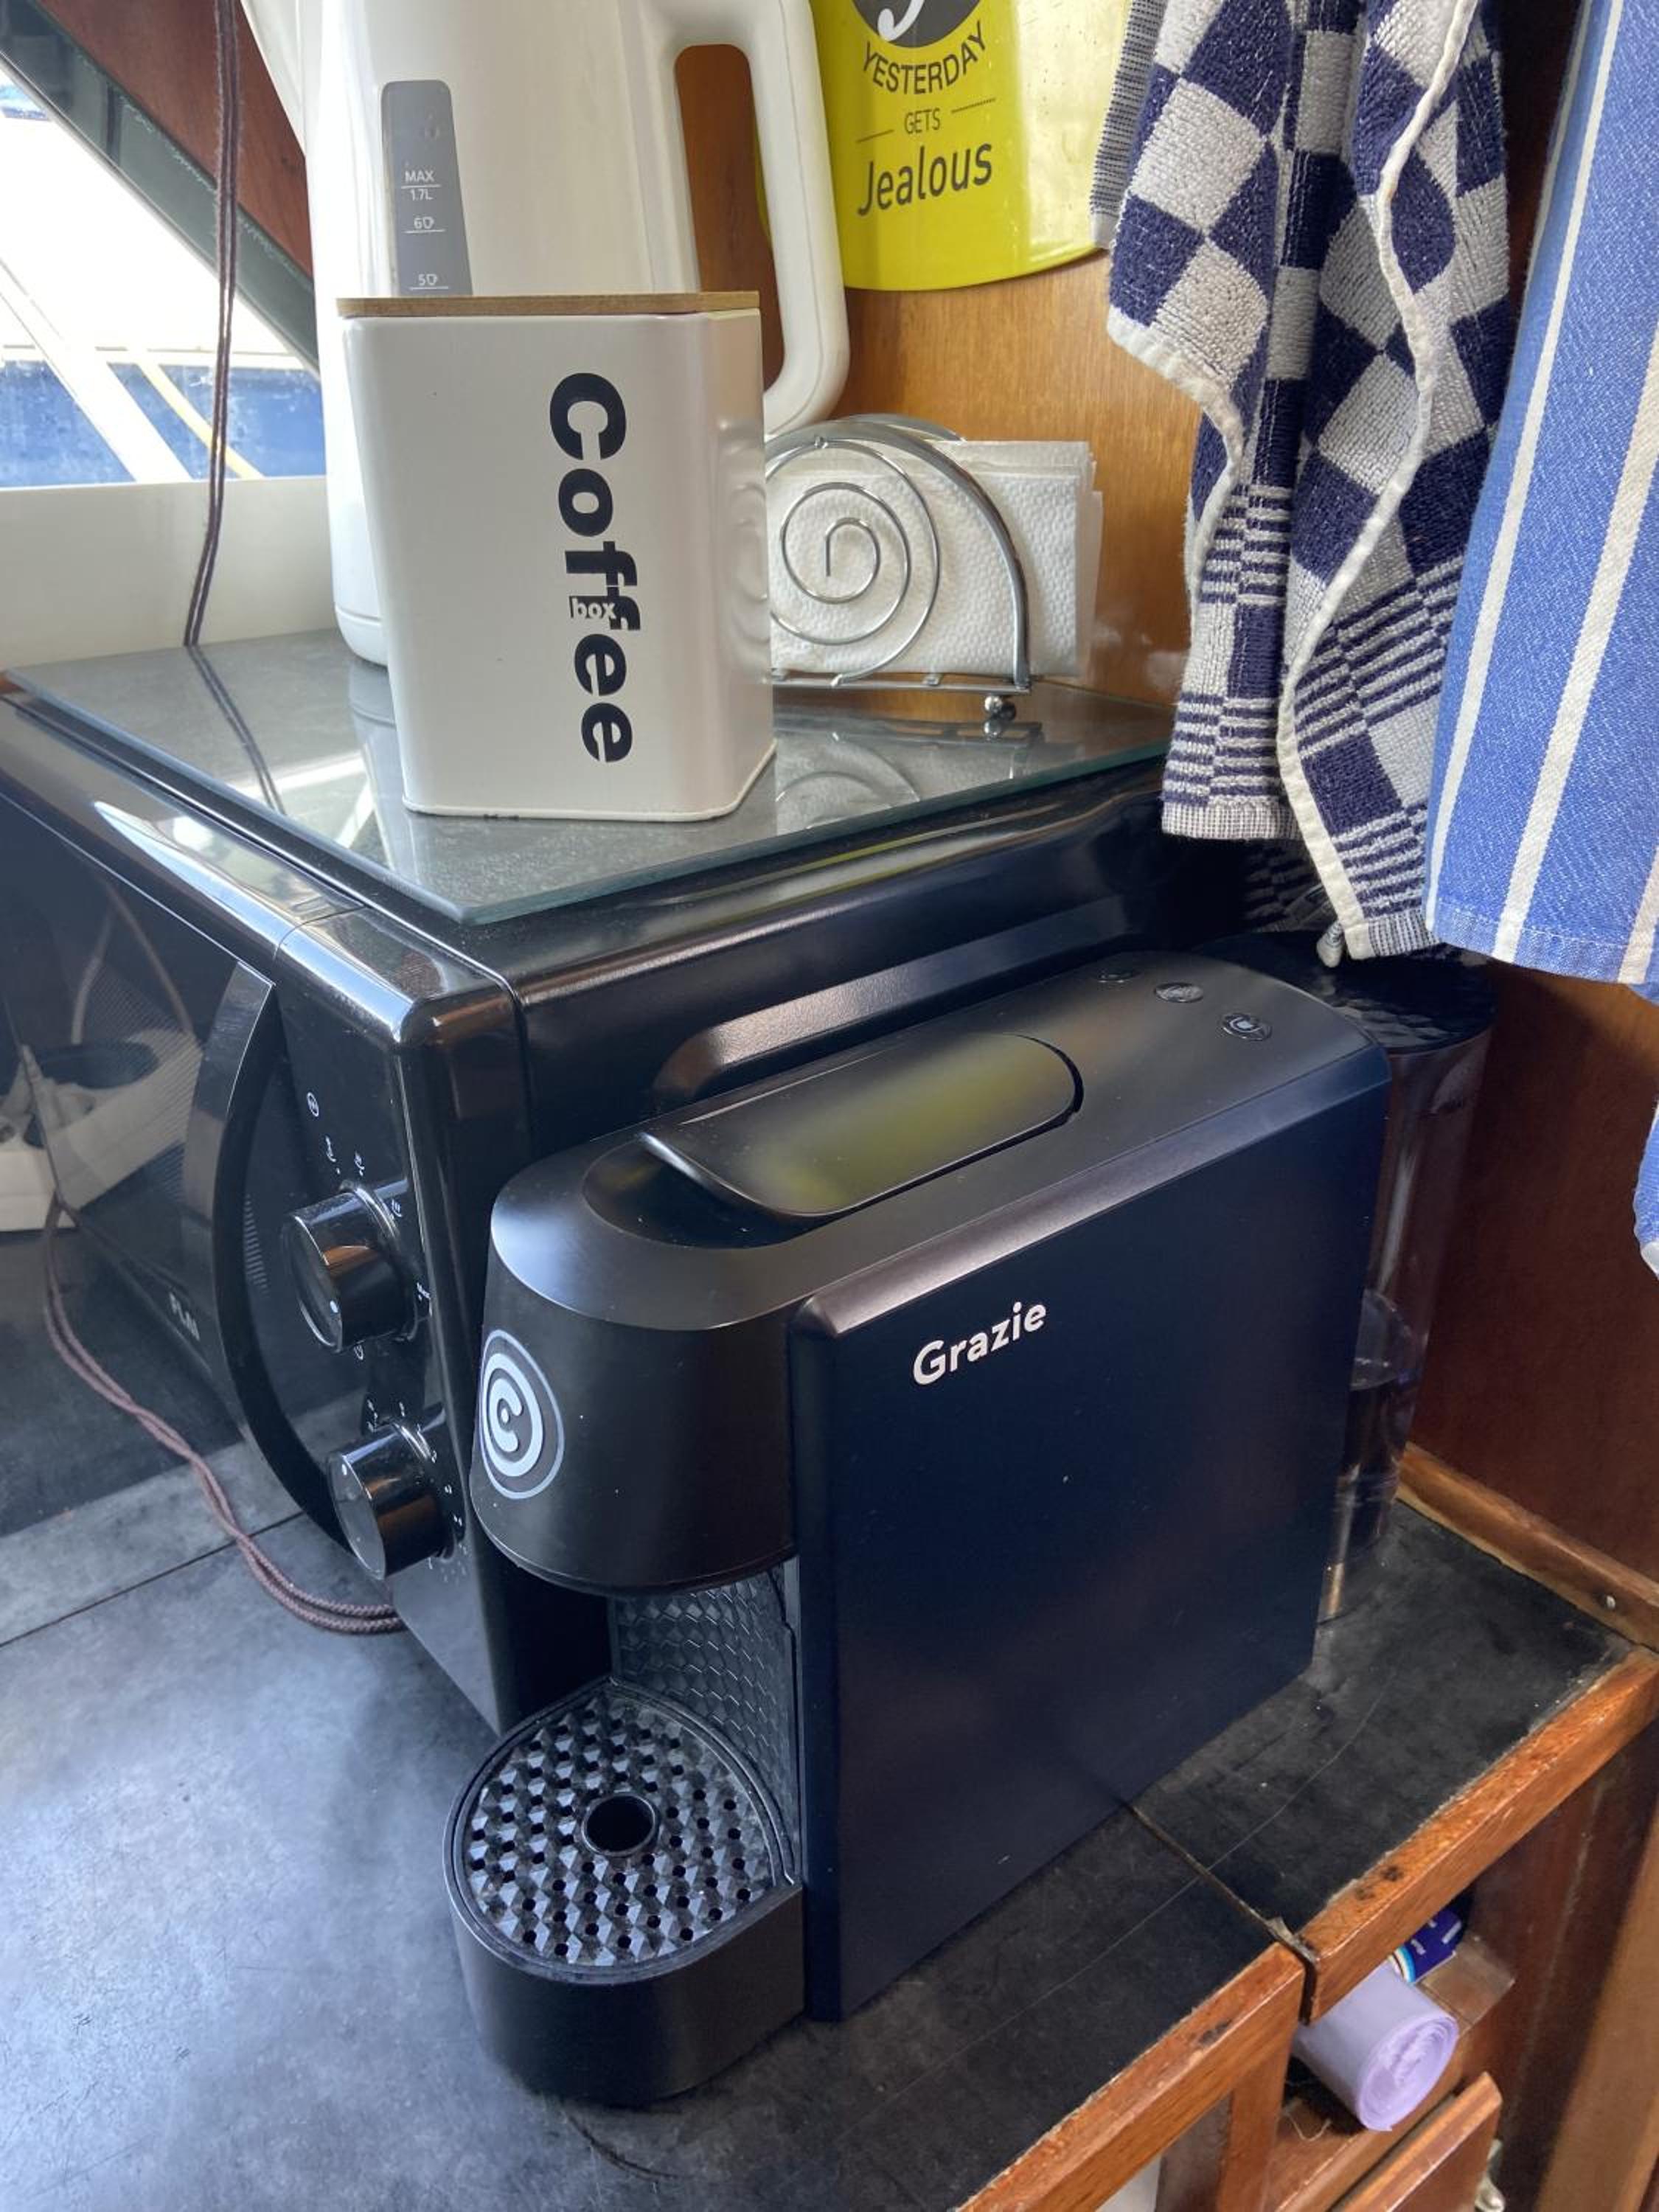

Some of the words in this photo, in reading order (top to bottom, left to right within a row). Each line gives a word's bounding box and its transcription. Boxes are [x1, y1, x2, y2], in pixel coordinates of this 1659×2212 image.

[863, 20, 986, 94] YESTERDAY
[904, 108, 941, 135] GETS
[405, 170, 435, 183] MAX
[410, 189, 433, 201] 1.7L
[857, 142, 992, 217] Jealous
[549, 372, 641, 762] Coffee
[571, 597, 616, 619] box
[913, 1301, 1047, 1385] Grazie
